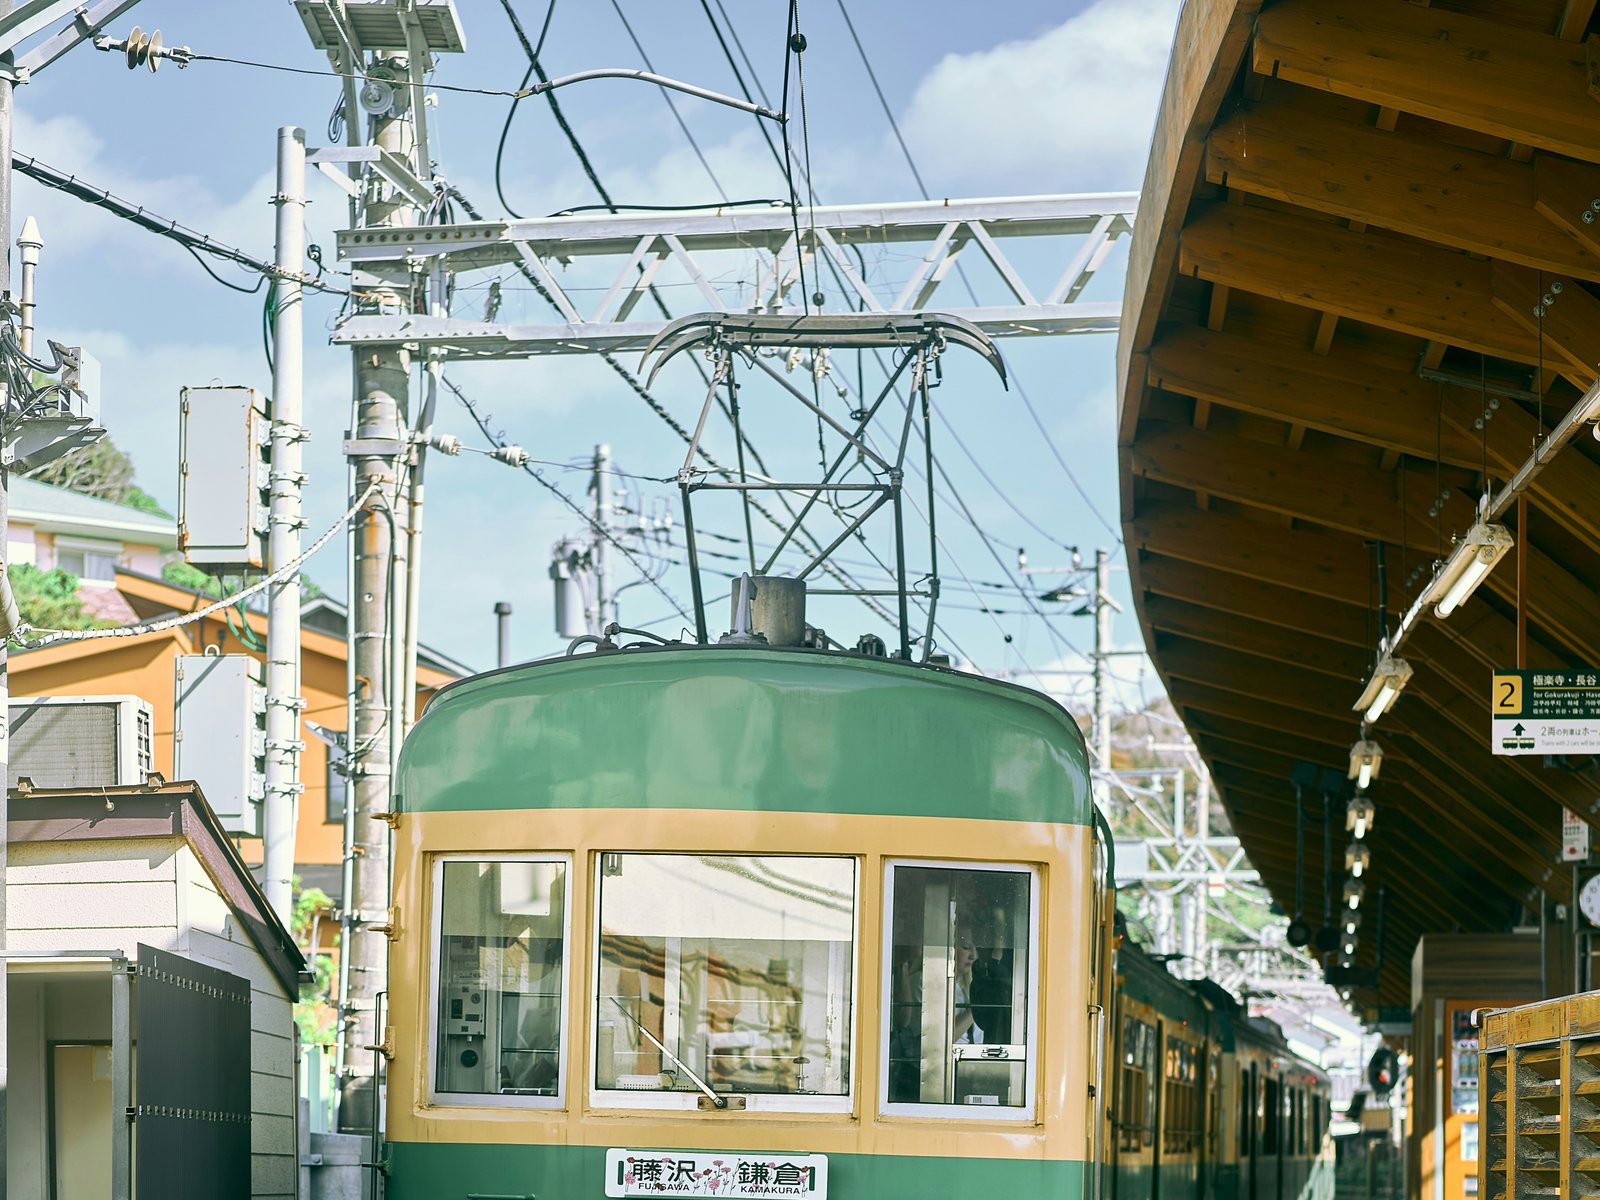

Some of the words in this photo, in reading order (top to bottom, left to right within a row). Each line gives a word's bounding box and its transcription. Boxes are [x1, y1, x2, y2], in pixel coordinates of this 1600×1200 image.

[1499, 682, 1515, 707] 2
[632, 1158, 696, 1183] 藤沢
[738, 1161, 801, 1186] 鎌倉
[638, 1182, 690, 1191] FUJSAWA
[740, 1186, 800, 1195] KAMAKURA
